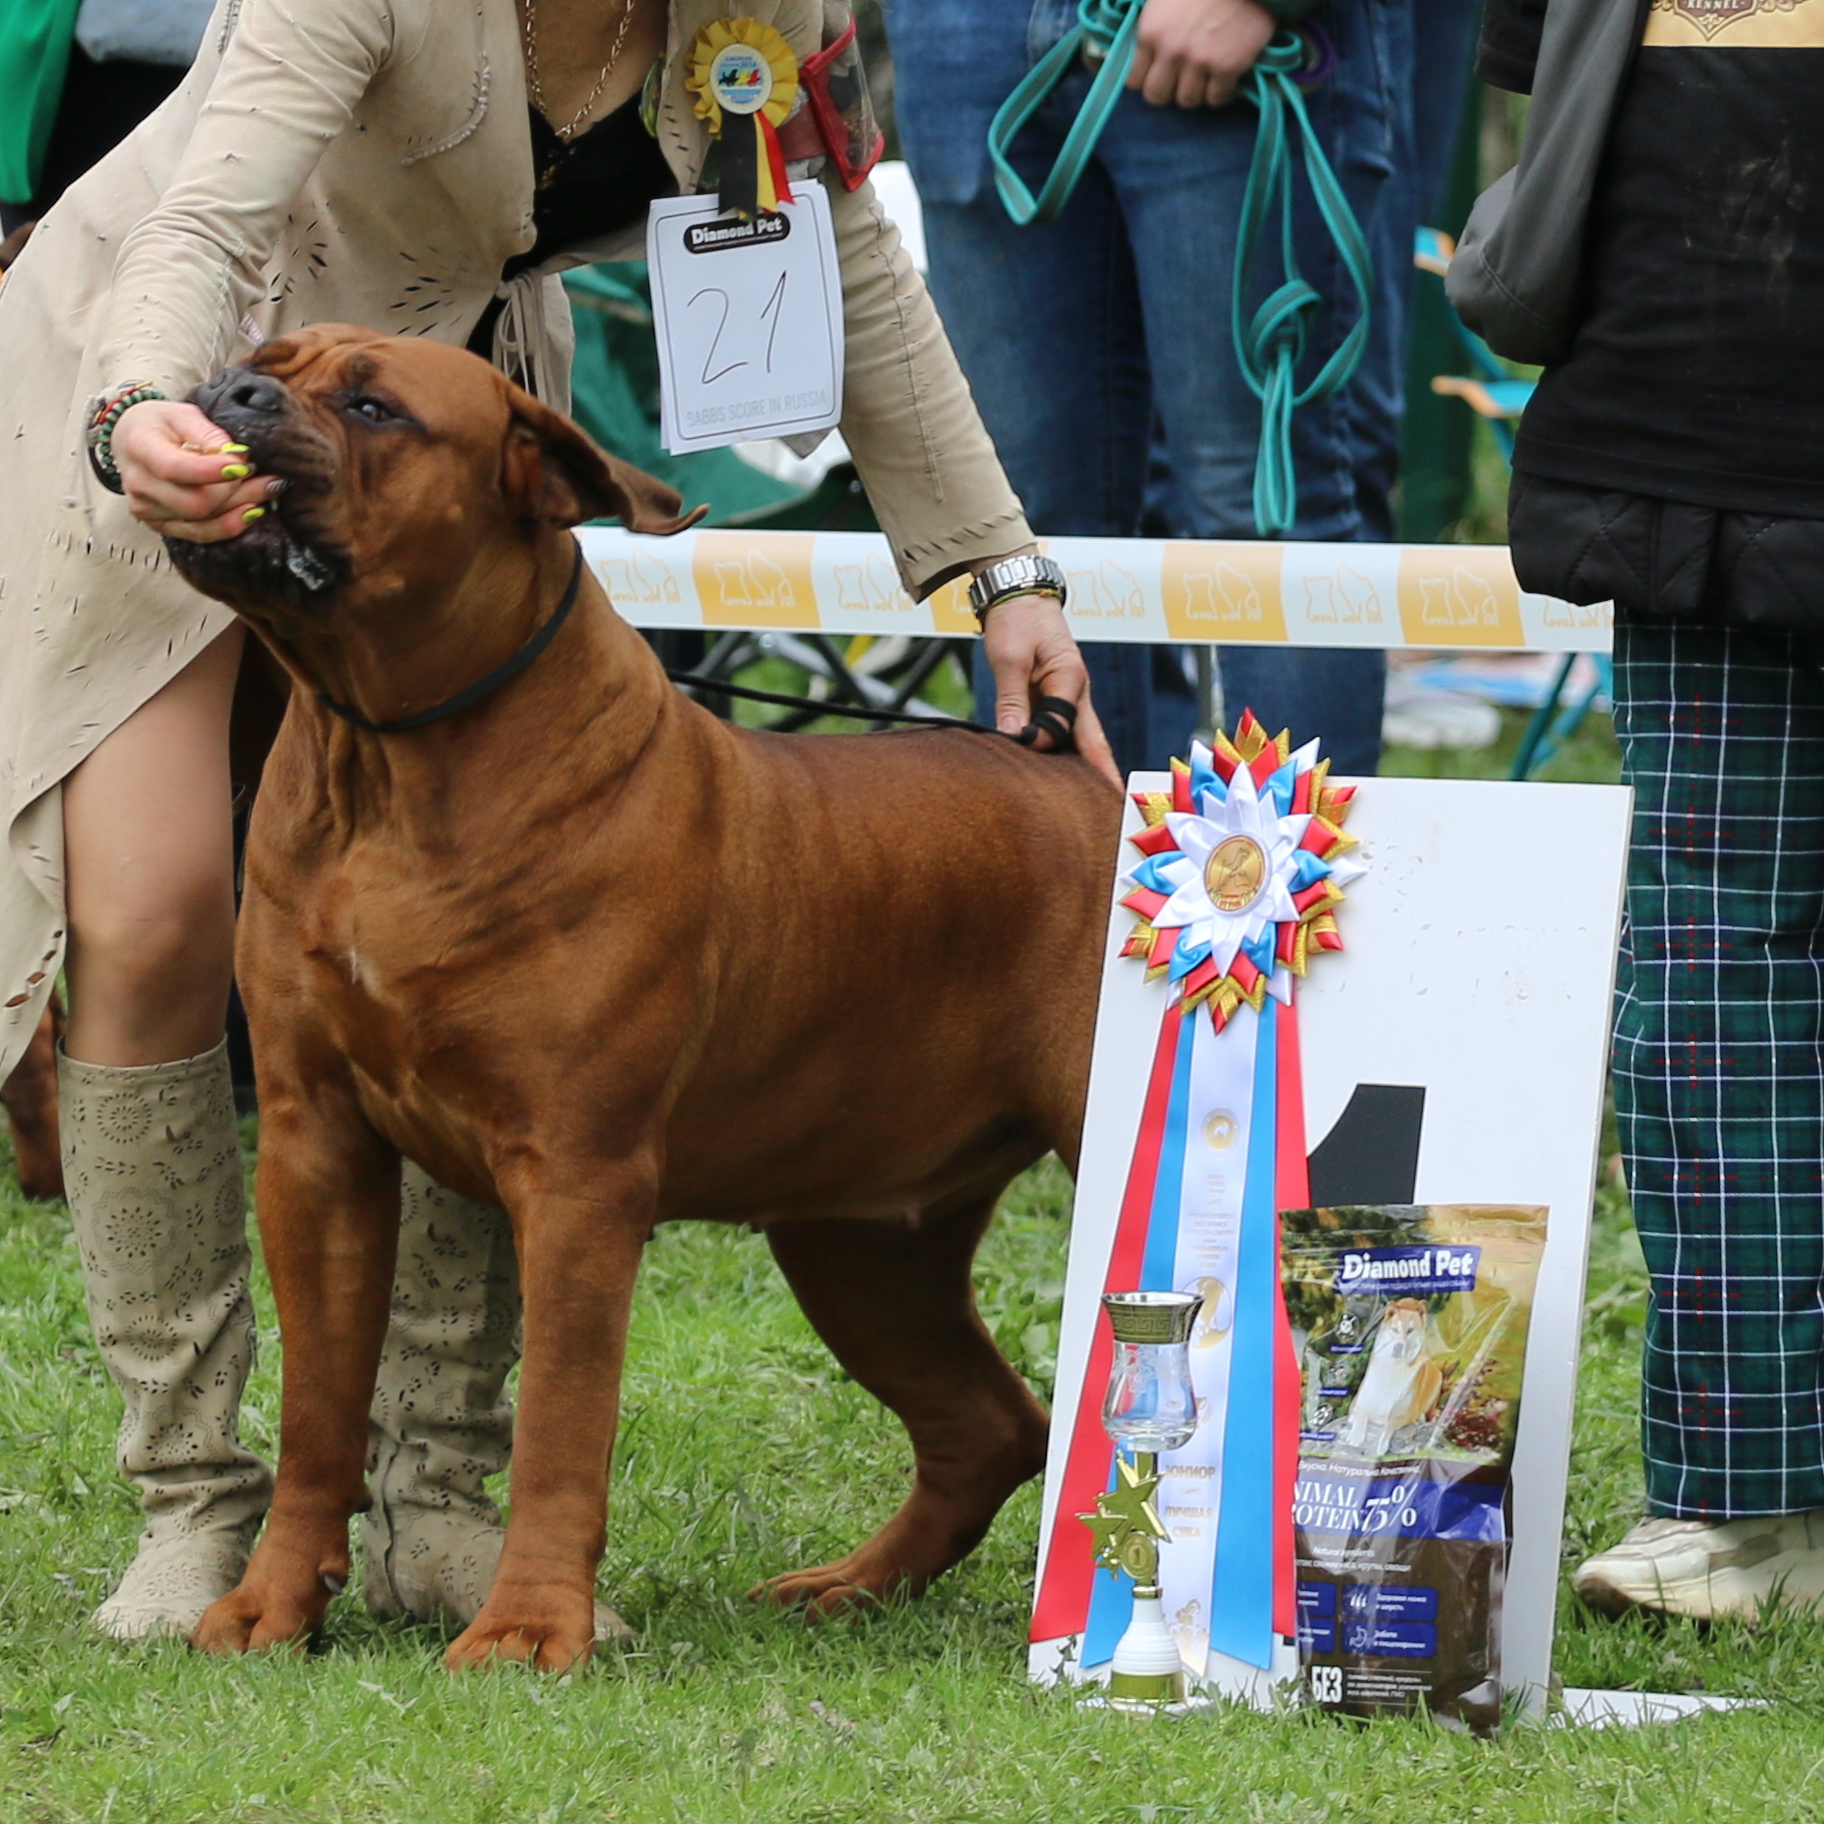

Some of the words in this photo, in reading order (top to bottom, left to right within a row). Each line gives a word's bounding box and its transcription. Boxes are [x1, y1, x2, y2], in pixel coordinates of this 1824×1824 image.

[690, 222, 755, 245] Diamond
[756, 217, 784, 235] Pet
[686, 269, 789, 385] 21
[686, 404, 727, 428] SABBS
[728, 398, 767, 422] SCORE
[769, 395, 782, 415] IN
[784, 389, 828, 413] RUSSIA
[1342, 1250, 1432, 1280] Diamond
[1435, 1249, 1474, 1277] Pet
[1165, 1464, 1216, 1480] ЮНИОР
[1294, 1480, 1358, 1508] NIMAL
[1361, 1482, 1419, 1533] 75%
[1164, 1505, 1213, 1519] ЛУЧШАЯ
[1292, 1504, 1364, 1531] OTEIN
[1171, 1525, 1201, 1538] СУКА
[1311, 1665, 1344, 1704] БЕЗ
